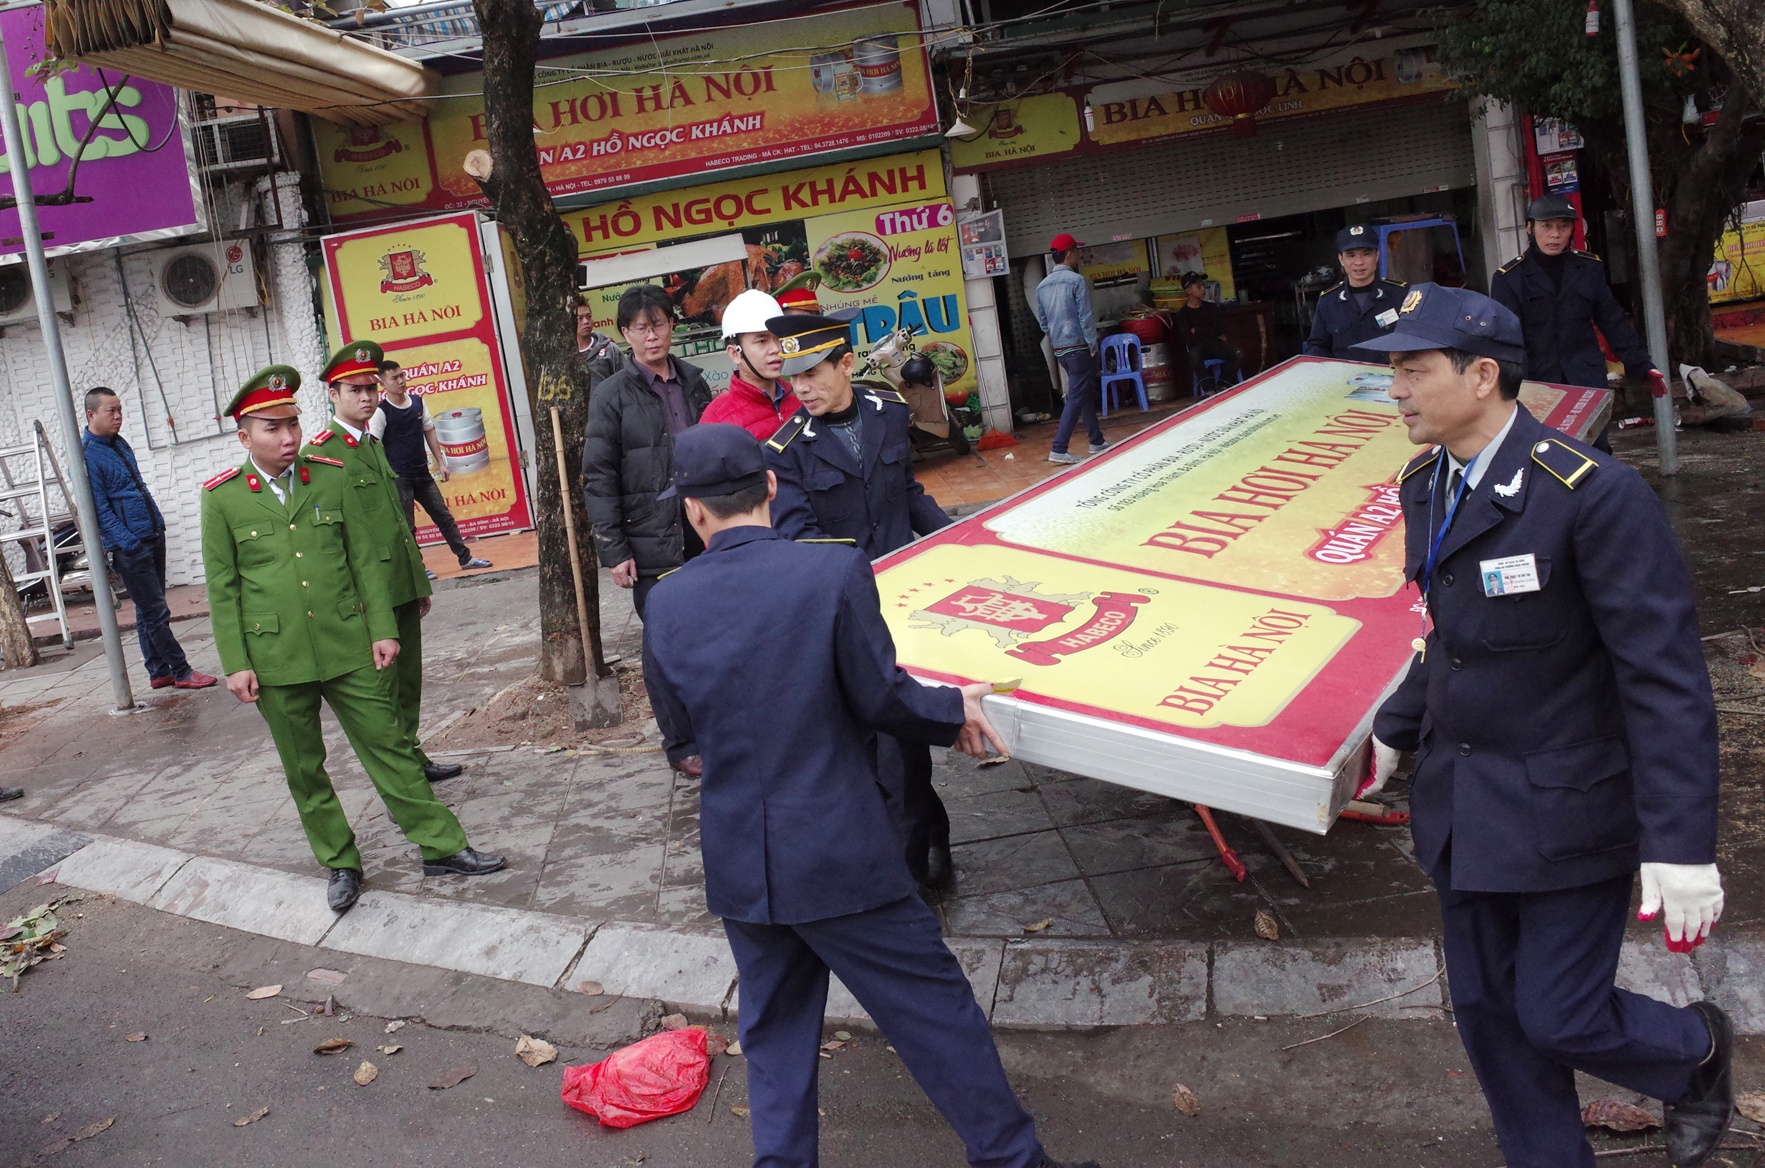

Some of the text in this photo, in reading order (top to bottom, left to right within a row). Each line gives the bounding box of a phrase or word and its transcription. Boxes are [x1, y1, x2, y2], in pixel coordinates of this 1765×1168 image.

[672, 46, 689, 56] KHÁT
[690, 44, 701, 53] HÀ
[701, 42, 714, 51] NỘI
[548, 90, 624, 128] HƠI
[635, 74, 696, 114] HÀ
[697, 64, 777, 103] NỘI
[1103, 95, 1169, 126] BIA
[1314, 55, 1387, 91] NỘI
[1189, 112, 1223, 127] QUÁN
[1278, 100, 1303, 114] LINH
[559, 144, 587, 162] A2
[591, 131, 623, 156] HỒ
[627, 127, 685, 151] NGỌC
[690, 114, 762, 140] KHÁNH
[705, 157, 731, 167] HABECO
[731, 153, 758, 163] TRADING
[582, 164, 928, 243] HỒ NGỌC KHÁNH
[879, 204, 953, 235] Thứ 6
[229, 264, 245, 275] LG
[393, 281, 421, 291] HABECO
[369, 304, 462, 331] BIA HÀ NỘI
[850, 289, 961, 347] TRÂU
[402, 360, 461, 380] QUÁN A2
[406, 383, 435, 398] GỌC
[438, 374, 488, 391] KHÁNH
[454, 492, 478, 508] HÀ
[480, 488, 507, 503] NỘI
[1075, 495, 1110, 509] TỔNG
[1100, 483, 1132, 497] CÔNG
[1121, 477, 1142, 485] TY
[1139, 408, 1401, 559] BIA HƠI HÀ NỘI
[1314, 522, 1385, 564] QUÁN
[1359, 505, 1403, 525] A2
[1057, 610, 1127, 649] HABECO
[1112, 622, 1180, 659] Since 1890
[1155, 607, 1313, 716] BIA HÀ NỘI
